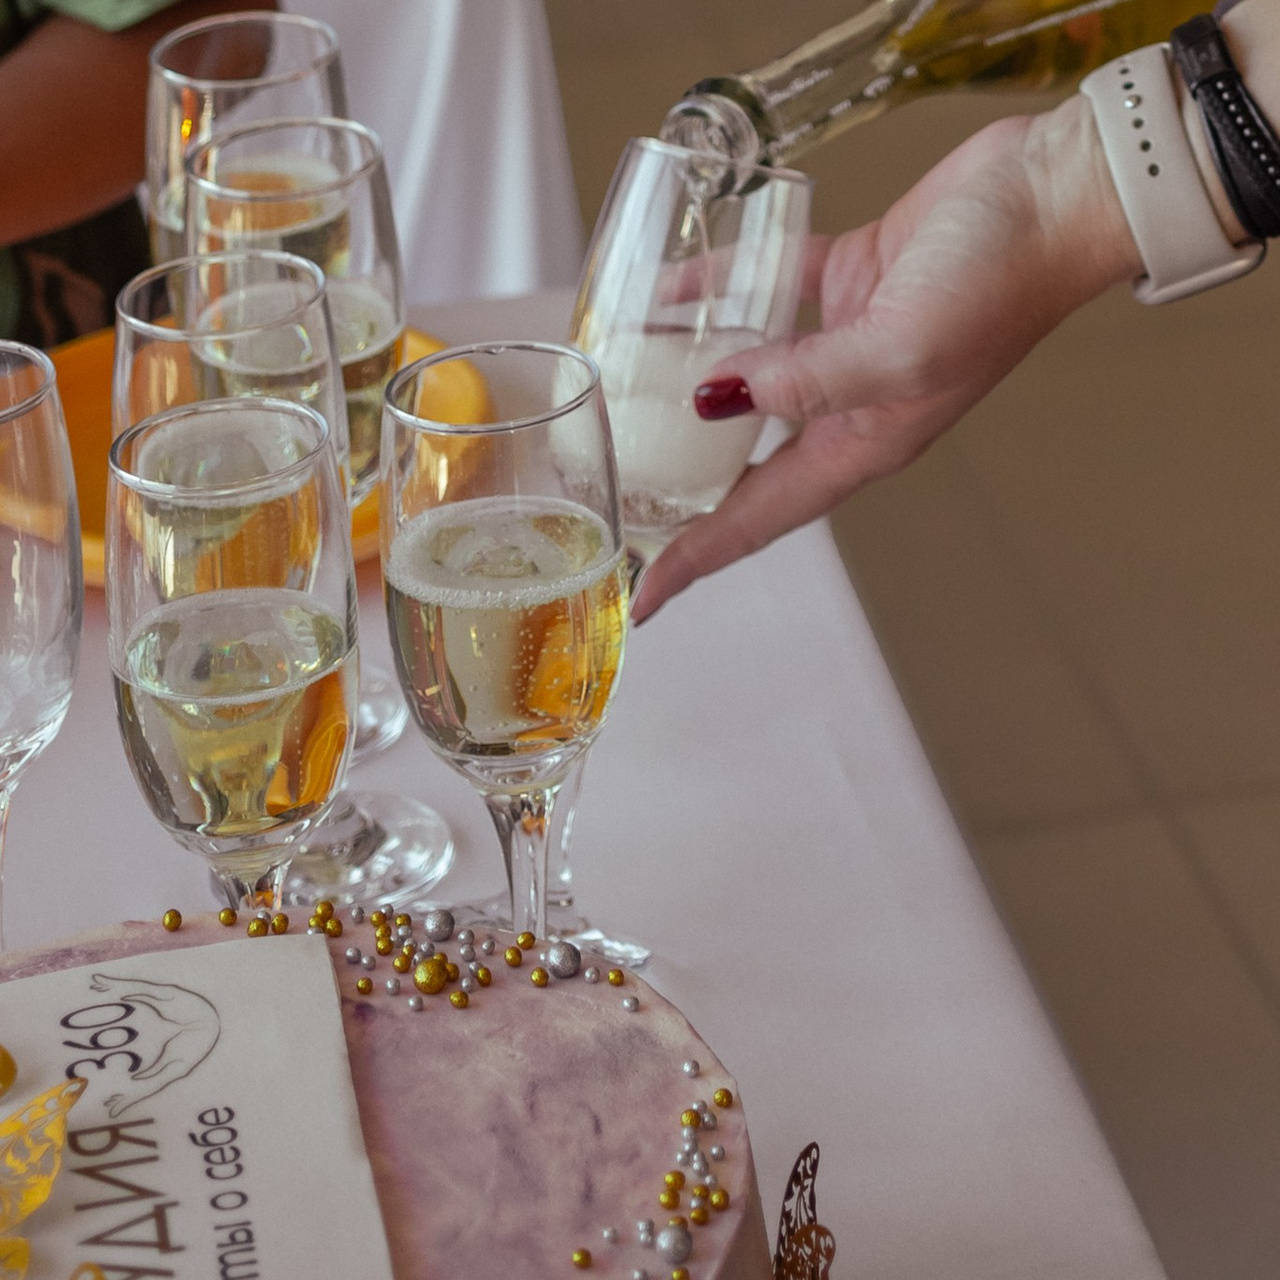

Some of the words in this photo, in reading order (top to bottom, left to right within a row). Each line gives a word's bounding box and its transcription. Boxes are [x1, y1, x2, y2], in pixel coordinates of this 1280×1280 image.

[60, 1002, 143, 1080] 360
[188, 1105, 244, 1180] себе
[210, 1189, 249, 1211] о
